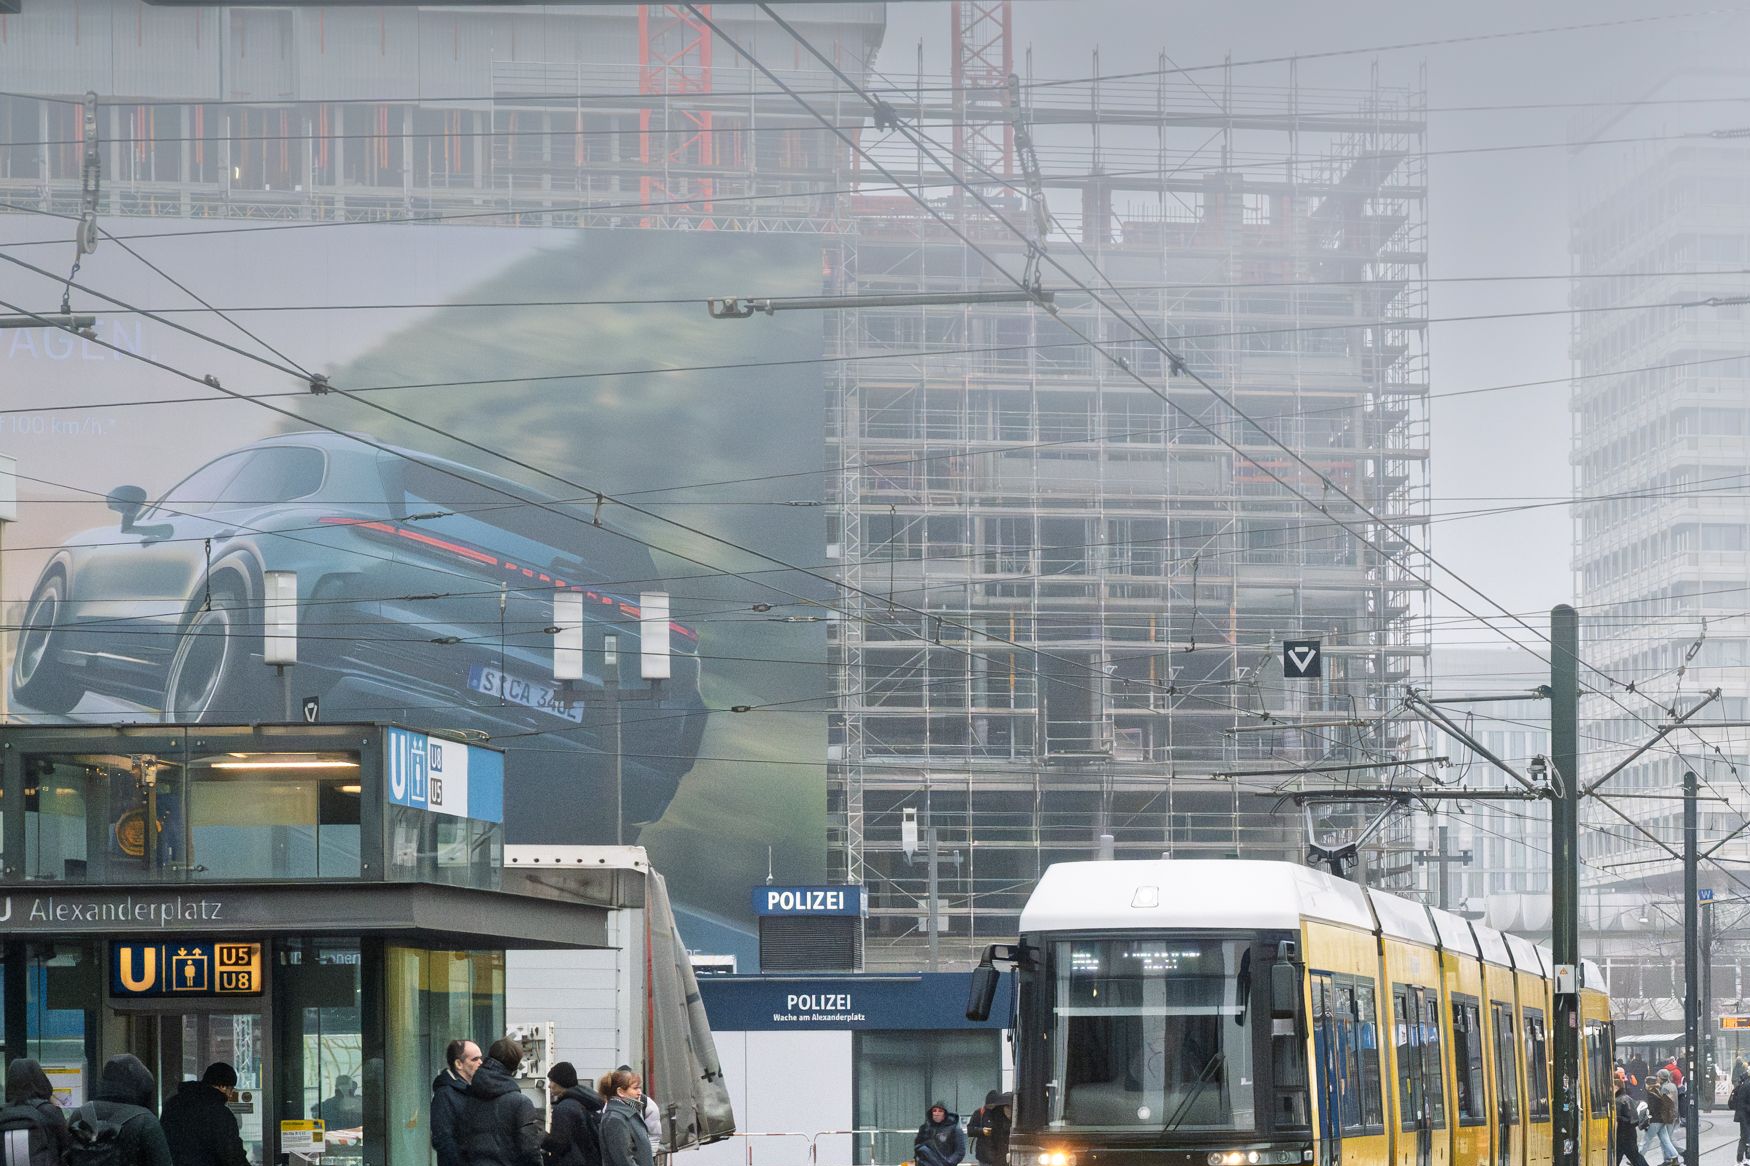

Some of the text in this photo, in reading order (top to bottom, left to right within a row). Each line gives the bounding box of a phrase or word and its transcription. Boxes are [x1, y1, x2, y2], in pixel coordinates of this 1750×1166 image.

[0, 320, 159, 361] AGEN.
[482, 672, 495, 691] S
[391, 732, 406, 800] U
[431, 747, 442, 770] U8
[431, 780, 442, 803] U5
[767, 891, 844, 910] POLIZEI
[30, 896, 223, 927] Alexanderplatz
[223, 948, 249, 965] U5
[120, 947, 156, 992] U
[223, 973, 249, 989] U8
[787, 994, 851, 1010] POLIZEI
[773, 1013, 797, 1021] Wache
[812, 1013, 865, 1022] Alexanderplatz
